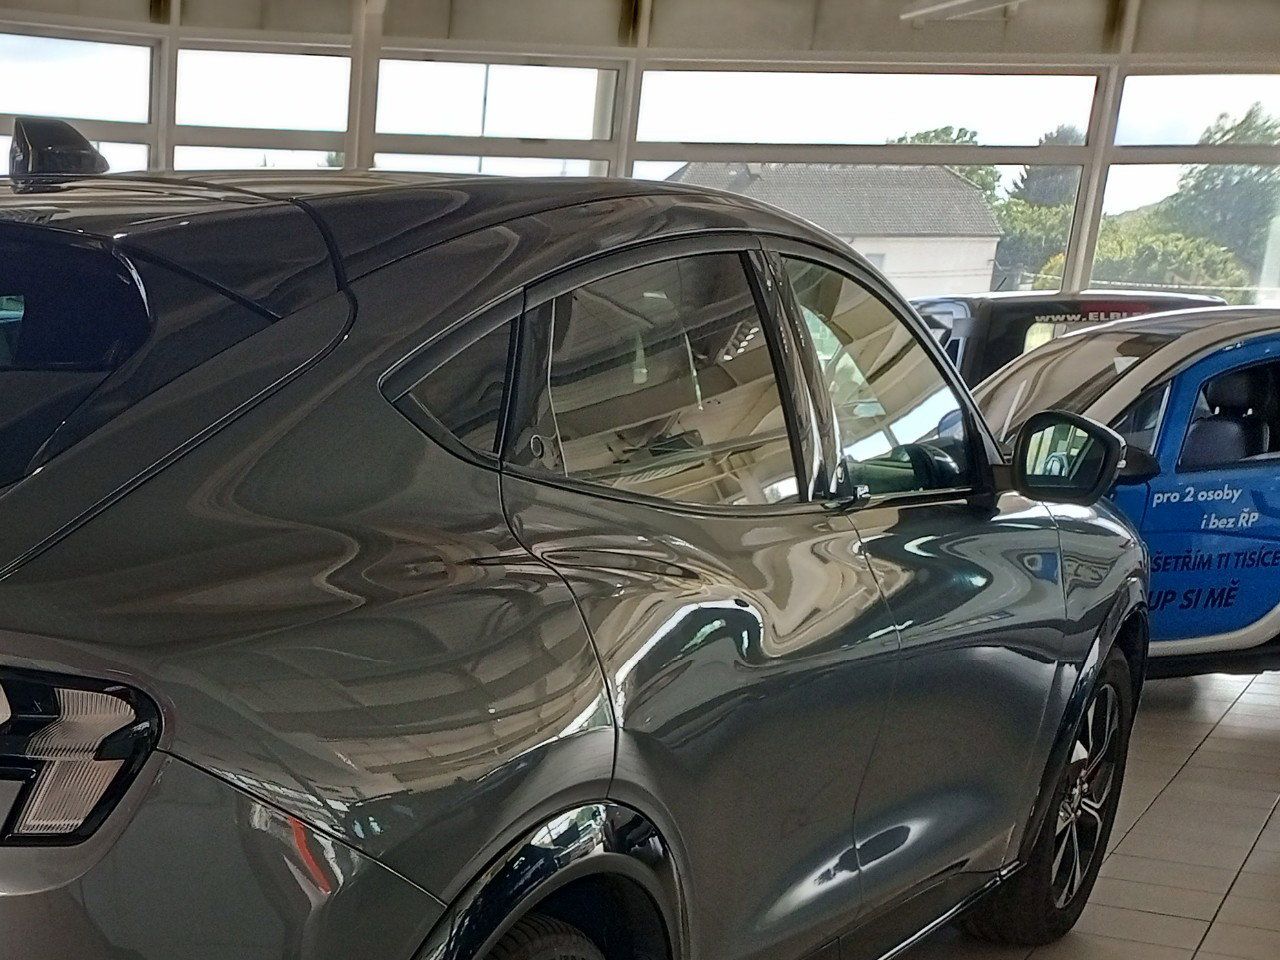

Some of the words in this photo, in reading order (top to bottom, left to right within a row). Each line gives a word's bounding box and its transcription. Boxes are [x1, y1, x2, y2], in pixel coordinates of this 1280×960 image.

[1152, 491, 1180, 508] pro
[1183, 486, 1195, 502] 2
[1197, 484, 1242, 504] osoby
[1201, 514, 1208, 529] i
[1208, 513, 1236, 529] bez
[1238, 507, 1259, 527] ŘP
[1217, 552, 1231, 570] TI
[1148, 589, 1177, 611] UP
[1179, 587, 1203, 610] SI
[1204, 578, 1240, 609] MĚ
